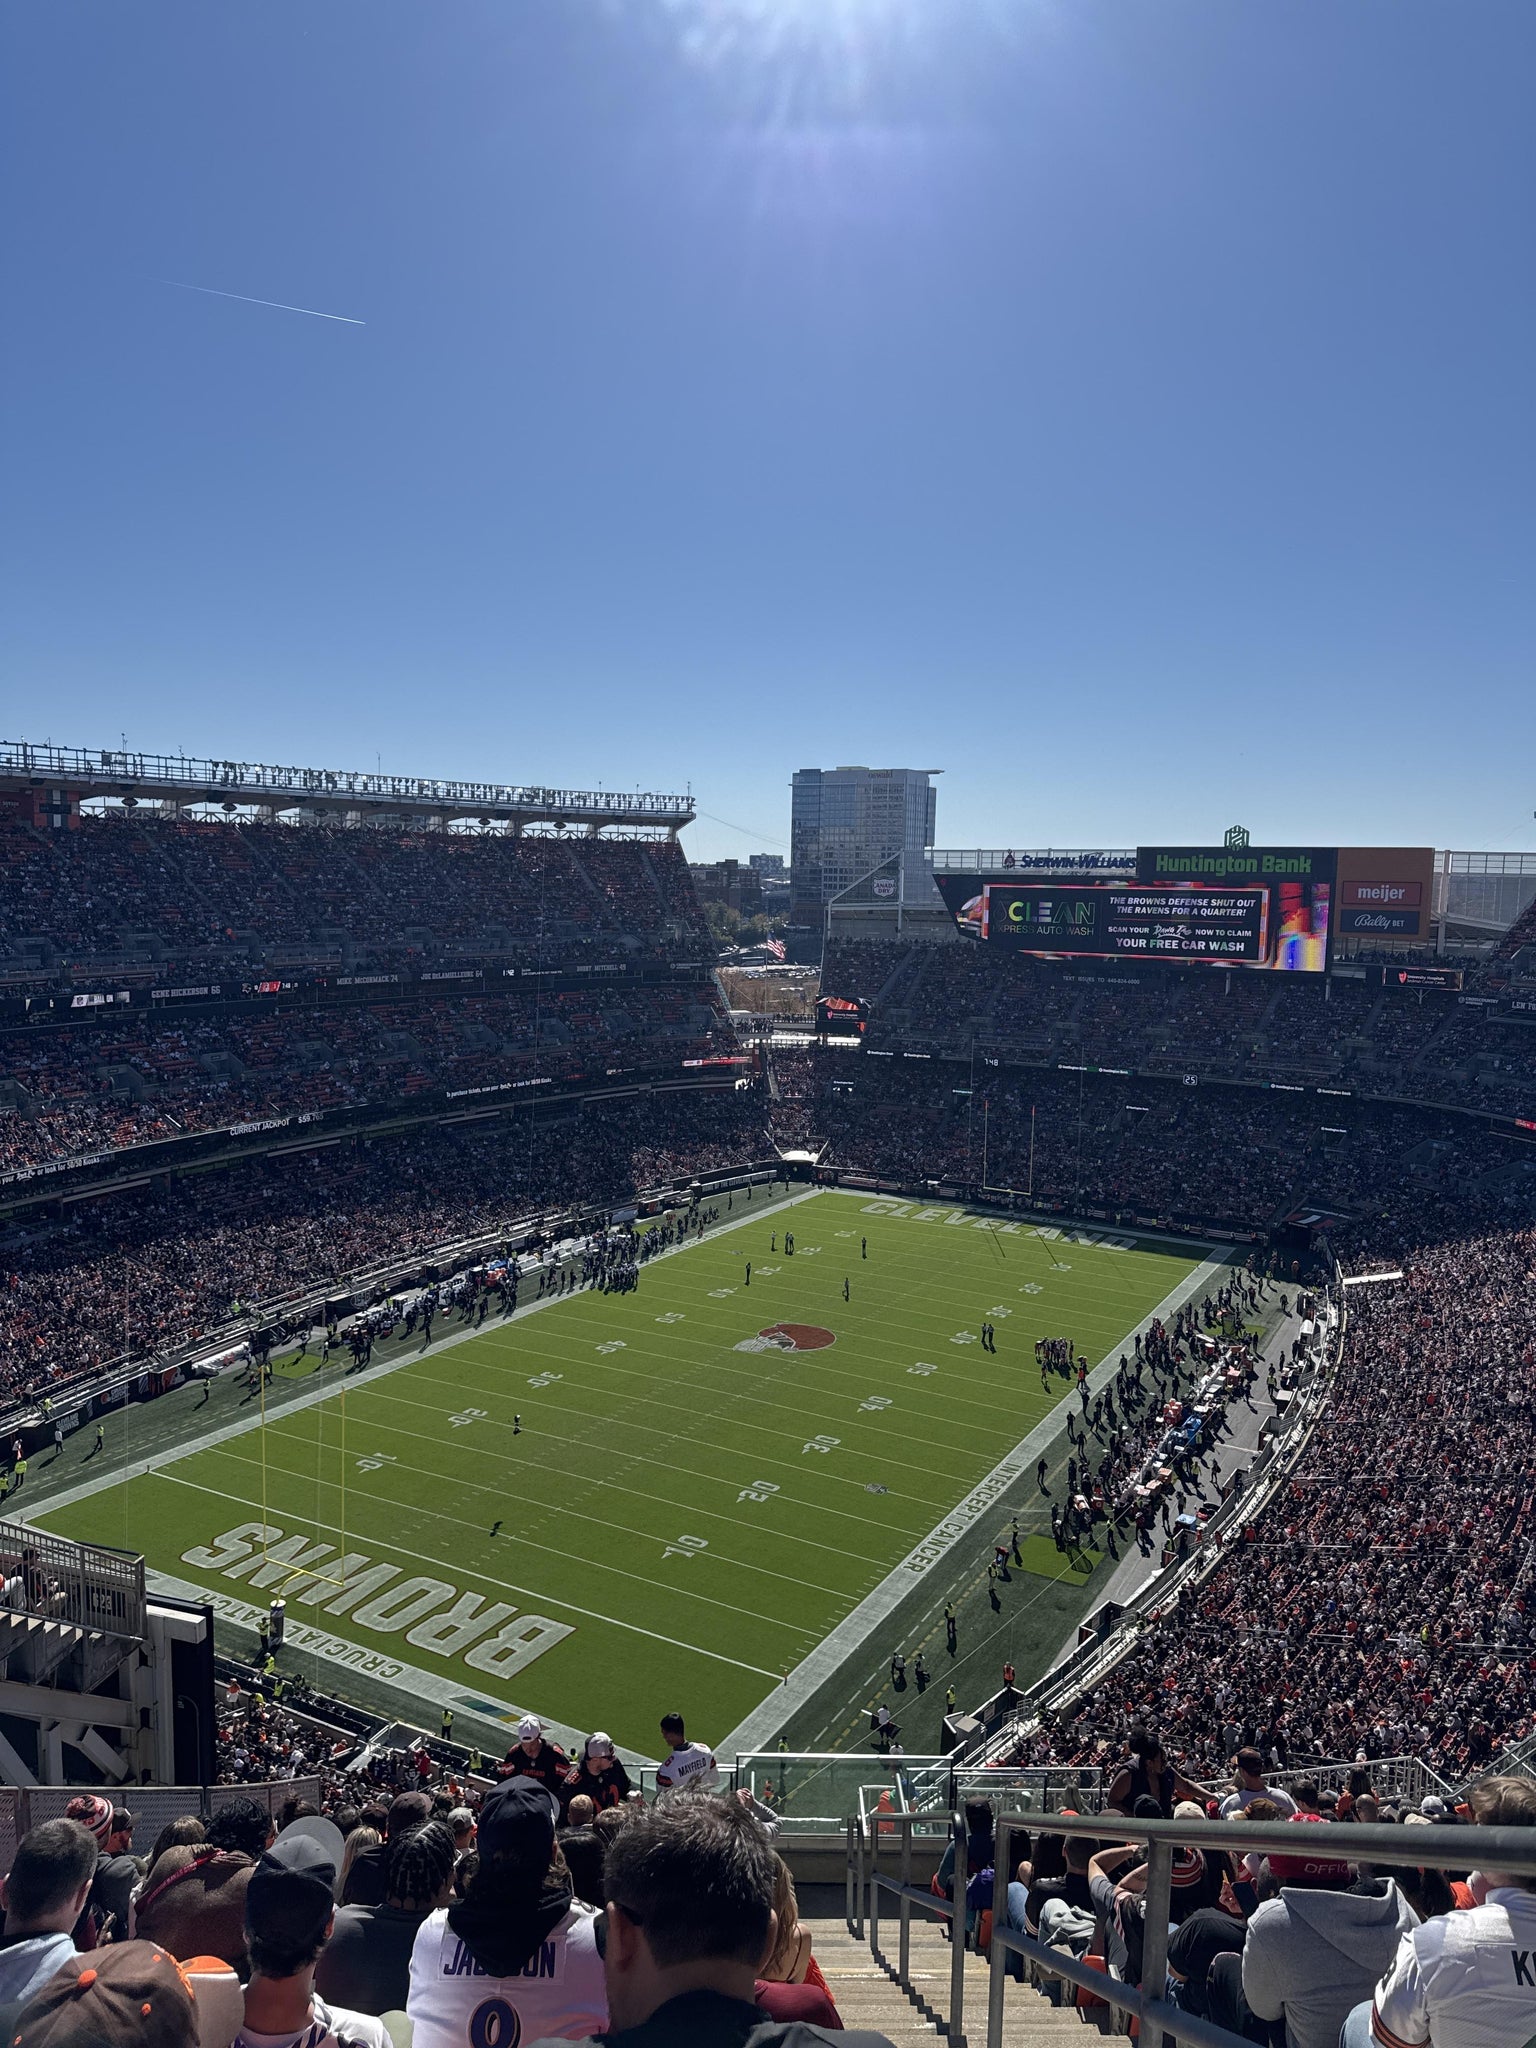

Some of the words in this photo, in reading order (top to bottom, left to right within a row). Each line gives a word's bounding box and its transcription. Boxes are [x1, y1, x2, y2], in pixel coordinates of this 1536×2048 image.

[1021, 854, 1136, 868] SHERWIN-WILLIAMS
[1156, 855, 1257, 876] Huntington
[1262, 855, 1311, 873] Bank
[1127, 897, 1166, 905] BROWNS
[1168, 898, 1208, 906] DEFENSE
[1210, 899, 1234, 907] SHUT
[1237, 899, 1256, 907] OUT
[1357, 884, 1406, 902] meijer
[1008, 901, 1095, 924] CLEAN
[1135, 906, 1169, 914] RAVENS
[1171, 907, 1190, 915] FOR
[1200, 908, 1246, 916] QUARTER!
[1036, 926, 1062, 935] AUTO
[1066, 927, 1093, 935] WASH
[1354, 914, 1390, 929] Bally
[1116, 938, 1146, 948] YOUR
[1150, 939, 1179, 949] FREE
[1181, 940, 1205, 950] CAR
[1209, 941, 1244, 951] WASH
[336, 977, 352, 985] MIKE
[390, 974, 399, 983] 74
[151, 989, 170, 999] GENE
[170, 987, 208, 997] HICKERSON
[211, 985, 221, 994] 66
[1512, 1001, 1526, 1009] LEN
[1185, 1075, 1196, 1084] 25
[229, 1124, 261, 1137] CURRENT
[262, 1118, 290, 1131] JACKPOT
[37, 1168, 44, 1176] or
[44, 1166, 57, 1174] look
[57, 1163, 67, 1171] for
[83, 1157, 100, 1166] Kiosks
[859, 1202, 1138, 1251] CLEVELAND
[655, 1312, 687, 1324] 50
[595, 1340, 627, 1352] 40
[907, 1362, 938, 1376] 50
[527, 1371, 564, 1387] 30
[861, 1395, 893, 1412] 40
[448, 1407, 488, 1426] 20
[803, 1434, 841, 1454] 30
[356, 1452, 397, 1471] 10
[739, 1480, 780, 1502] 20
[961, 1462, 1022, 1521] INTERCEPT
[667, 1535, 708, 1558] 10
[903, 1521, 964, 1574] CANCER
[180, 1522, 577, 1680] BROWNS
[196, 1593, 264, 1622] ATCH
[285, 1624, 404, 1679] CRUCIAL
[678, 1757, 707, 1777] MAYFIELD
